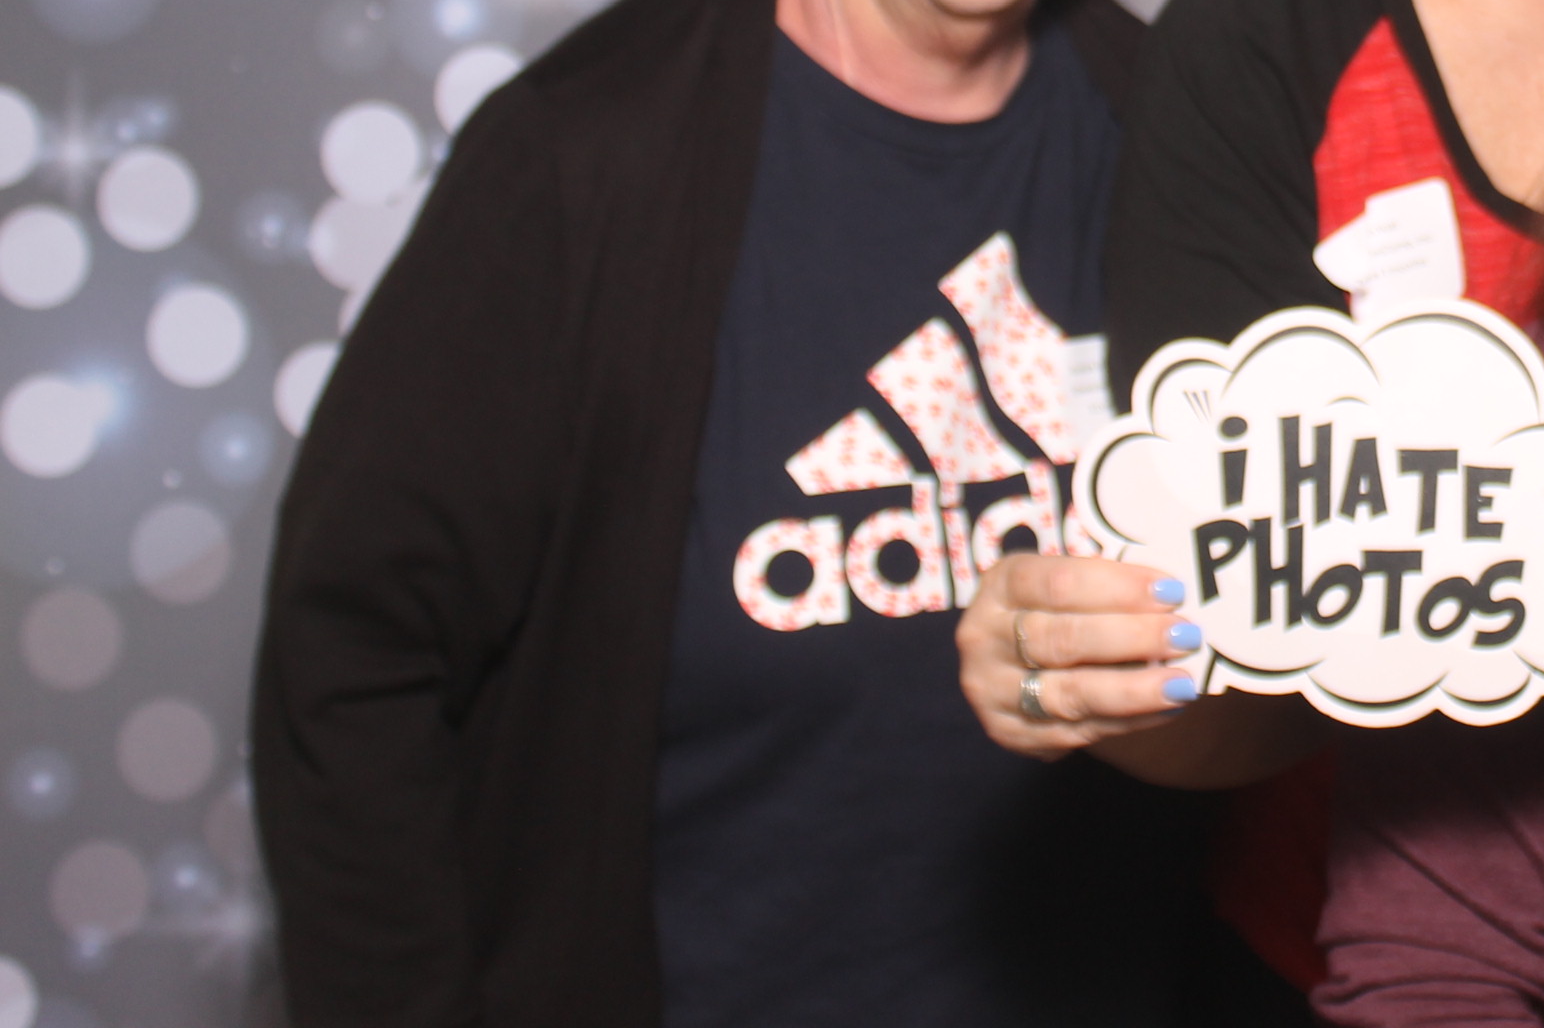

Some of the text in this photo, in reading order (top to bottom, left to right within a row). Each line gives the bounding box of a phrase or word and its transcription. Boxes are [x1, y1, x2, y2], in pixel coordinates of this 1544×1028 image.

[1276, 414, 1514, 541] HATE
[733, 458, 1104, 632] adid
[1192, 516, 1527, 648] PHOTOS
